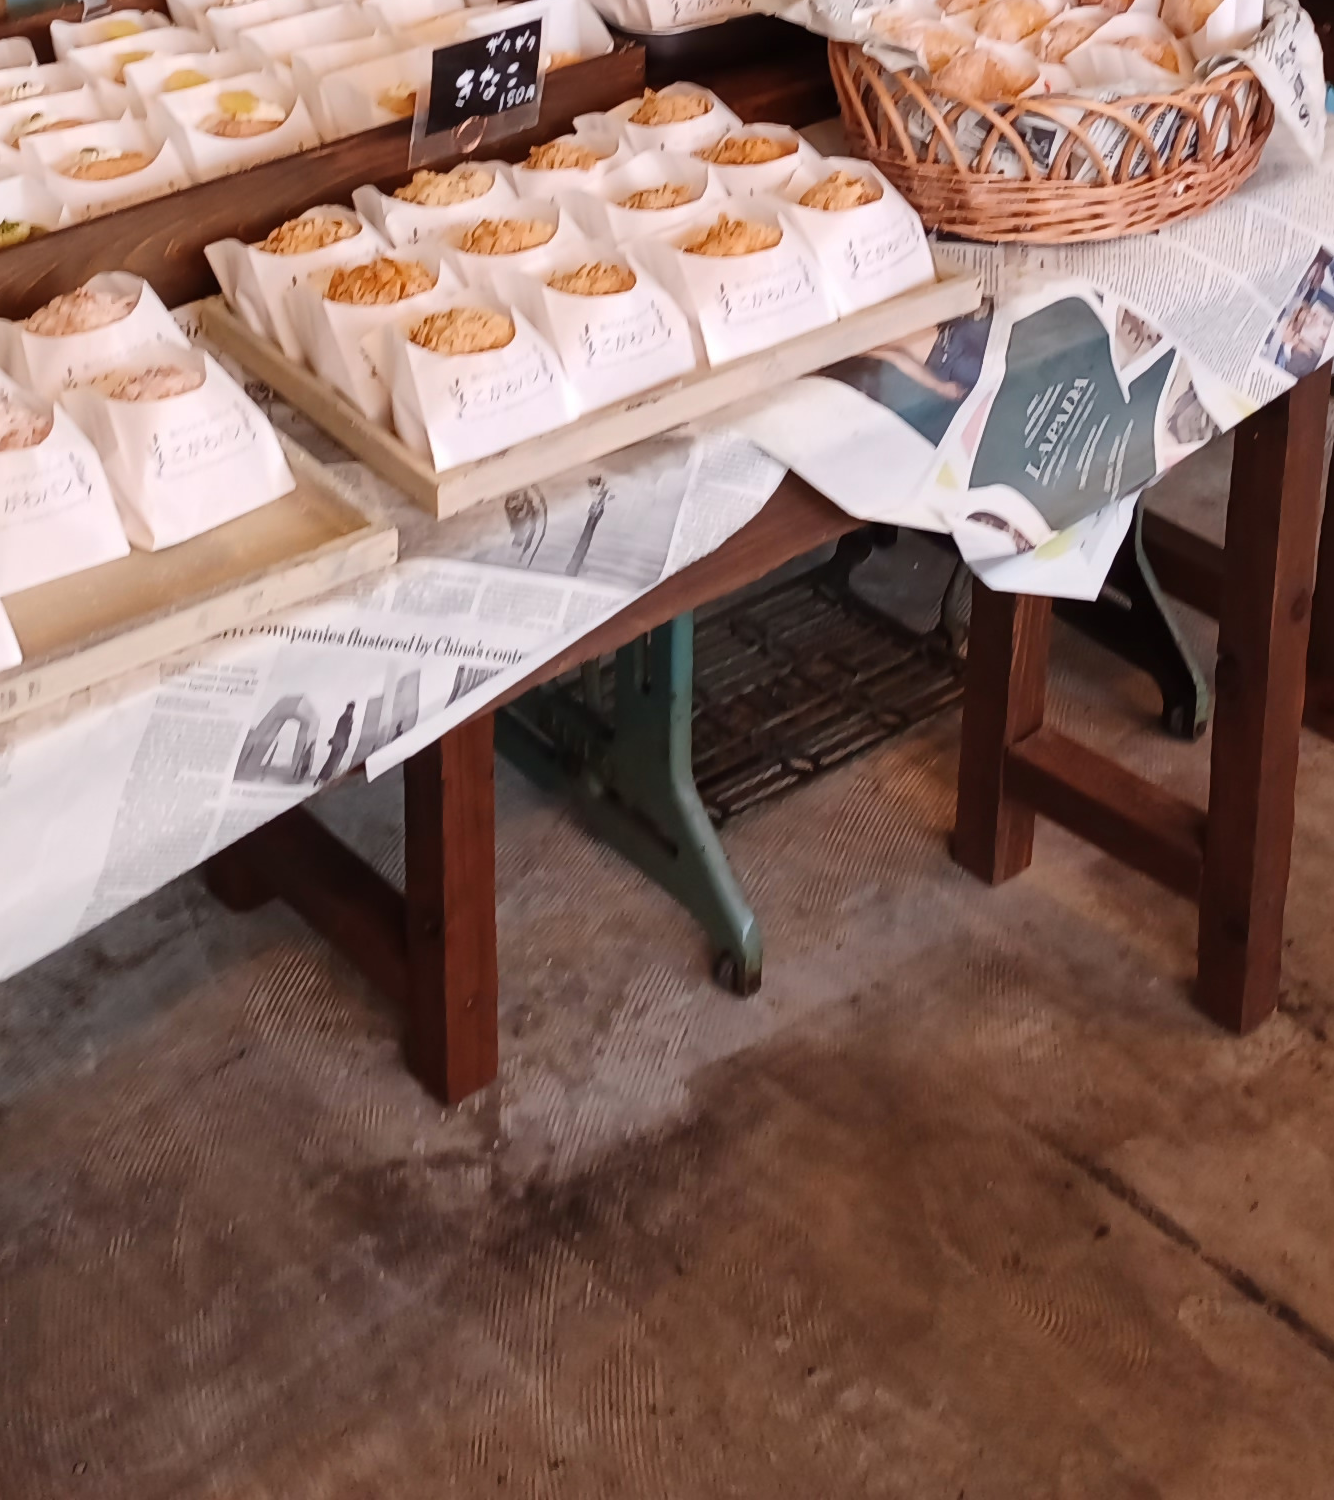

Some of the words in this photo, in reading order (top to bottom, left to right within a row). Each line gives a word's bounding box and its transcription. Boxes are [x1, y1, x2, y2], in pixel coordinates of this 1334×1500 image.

[454, 61, 521, 108] きなこ
[498, 84, 536, 113] 150円
[1025, 378, 1089, 481] LAPADA
[248, 624, 346, 645] companies
[346, 626, 417, 653] flustered
[415, 634, 433, 658] by
[434, 636, 484, 658] China's
